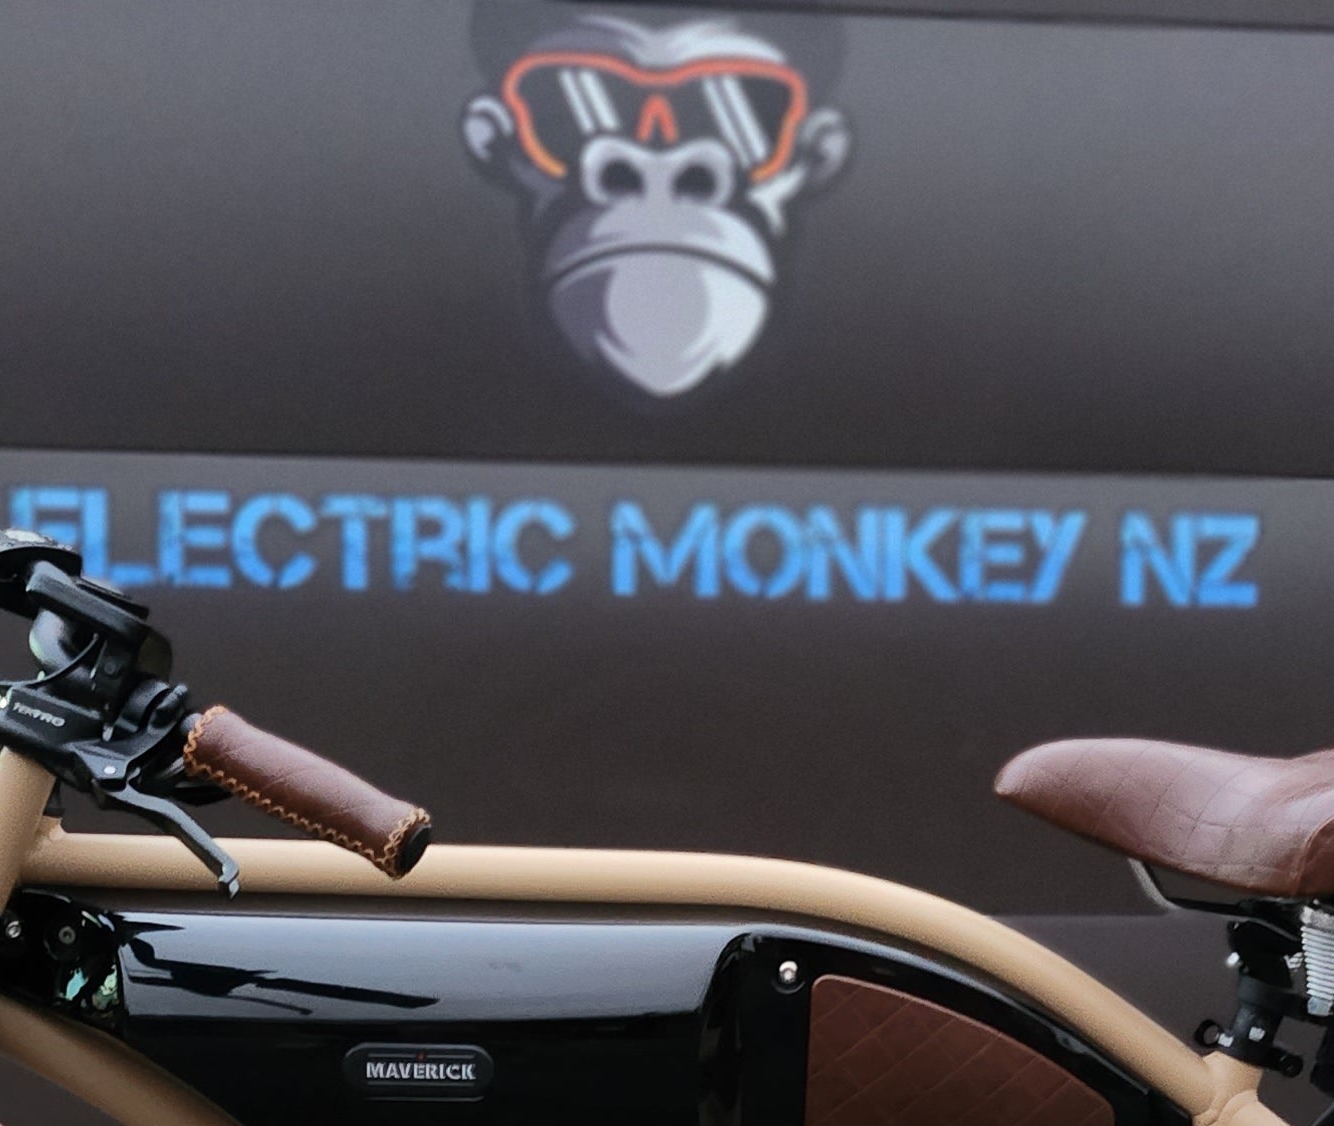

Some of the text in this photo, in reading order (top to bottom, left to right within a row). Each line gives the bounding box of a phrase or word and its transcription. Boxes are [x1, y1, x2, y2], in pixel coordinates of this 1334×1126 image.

[611, 502, 1087, 604] MONKEY
[1120, 512, 1260, 609] NZ
[366, 1063, 476, 1080] MAVERICK
